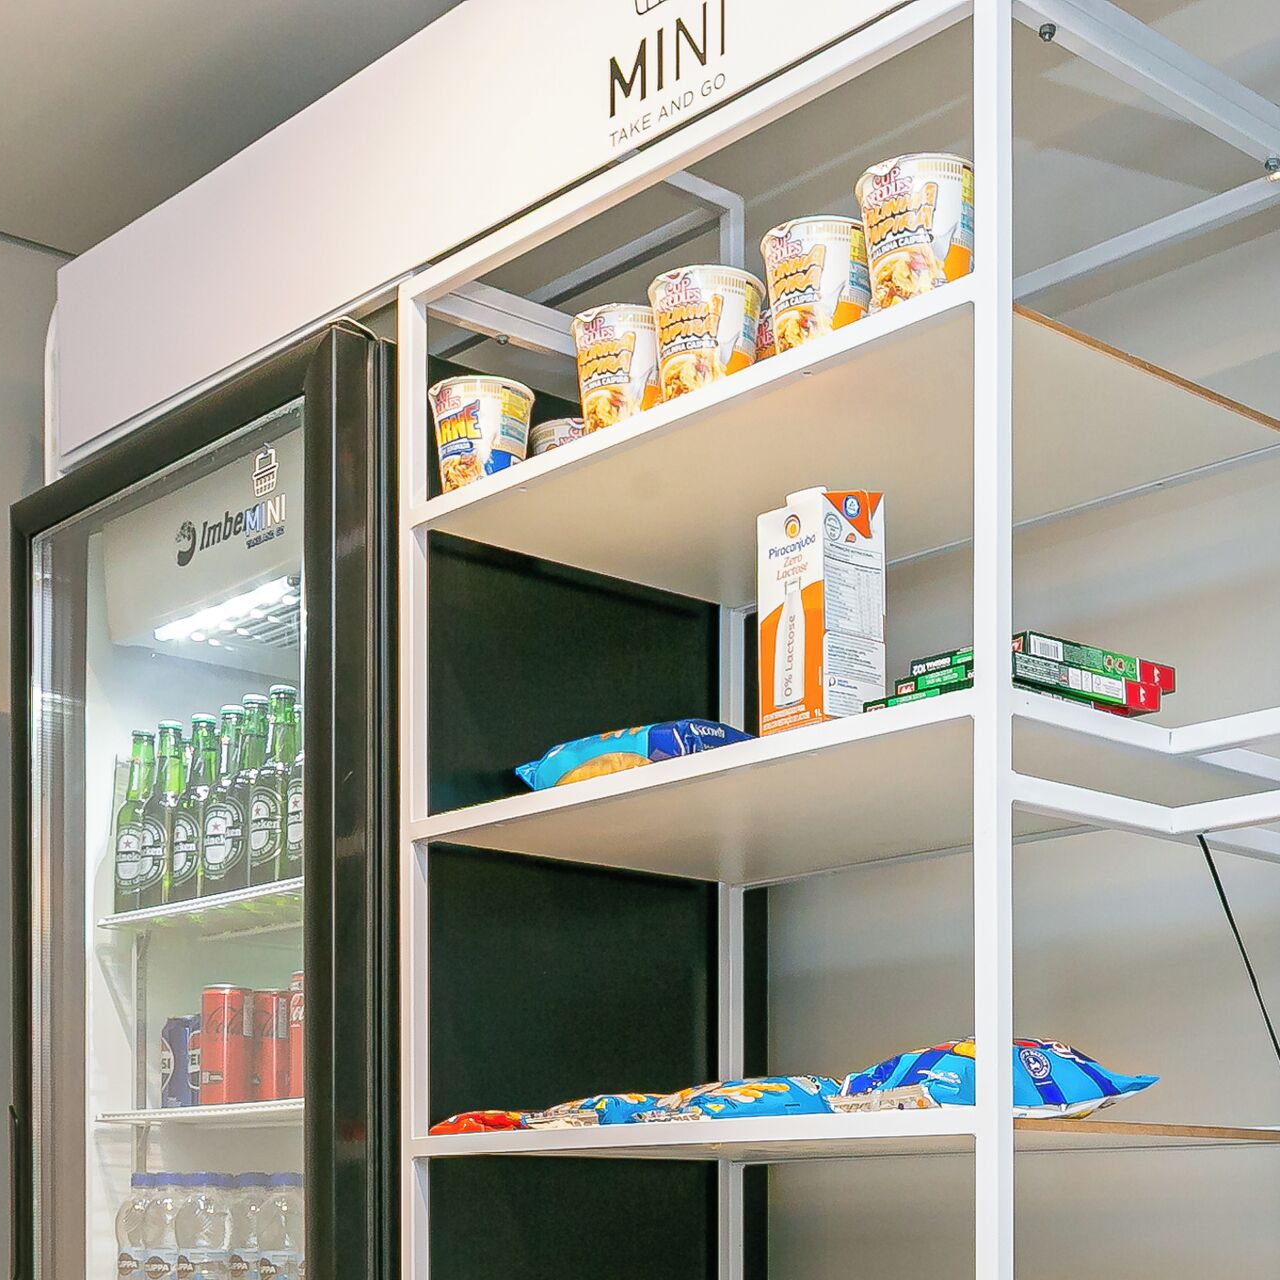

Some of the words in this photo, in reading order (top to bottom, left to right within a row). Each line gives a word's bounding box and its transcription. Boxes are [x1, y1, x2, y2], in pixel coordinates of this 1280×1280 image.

[609, 0, 724, 118] MINI
[610, 113, 651, 147] TAKE
[658, 91, 694, 121] AND
[701, 73, 726, 97] GO
[873, 167, 900, 189] CUP
[665, 278, 690, 296] CUP
[200, 510, 247, 551] Imbe
[245, 494, 286, 537] MINI
[783, 552, 803, 568] Zero
[785, 614, 796, 671] Lactose
